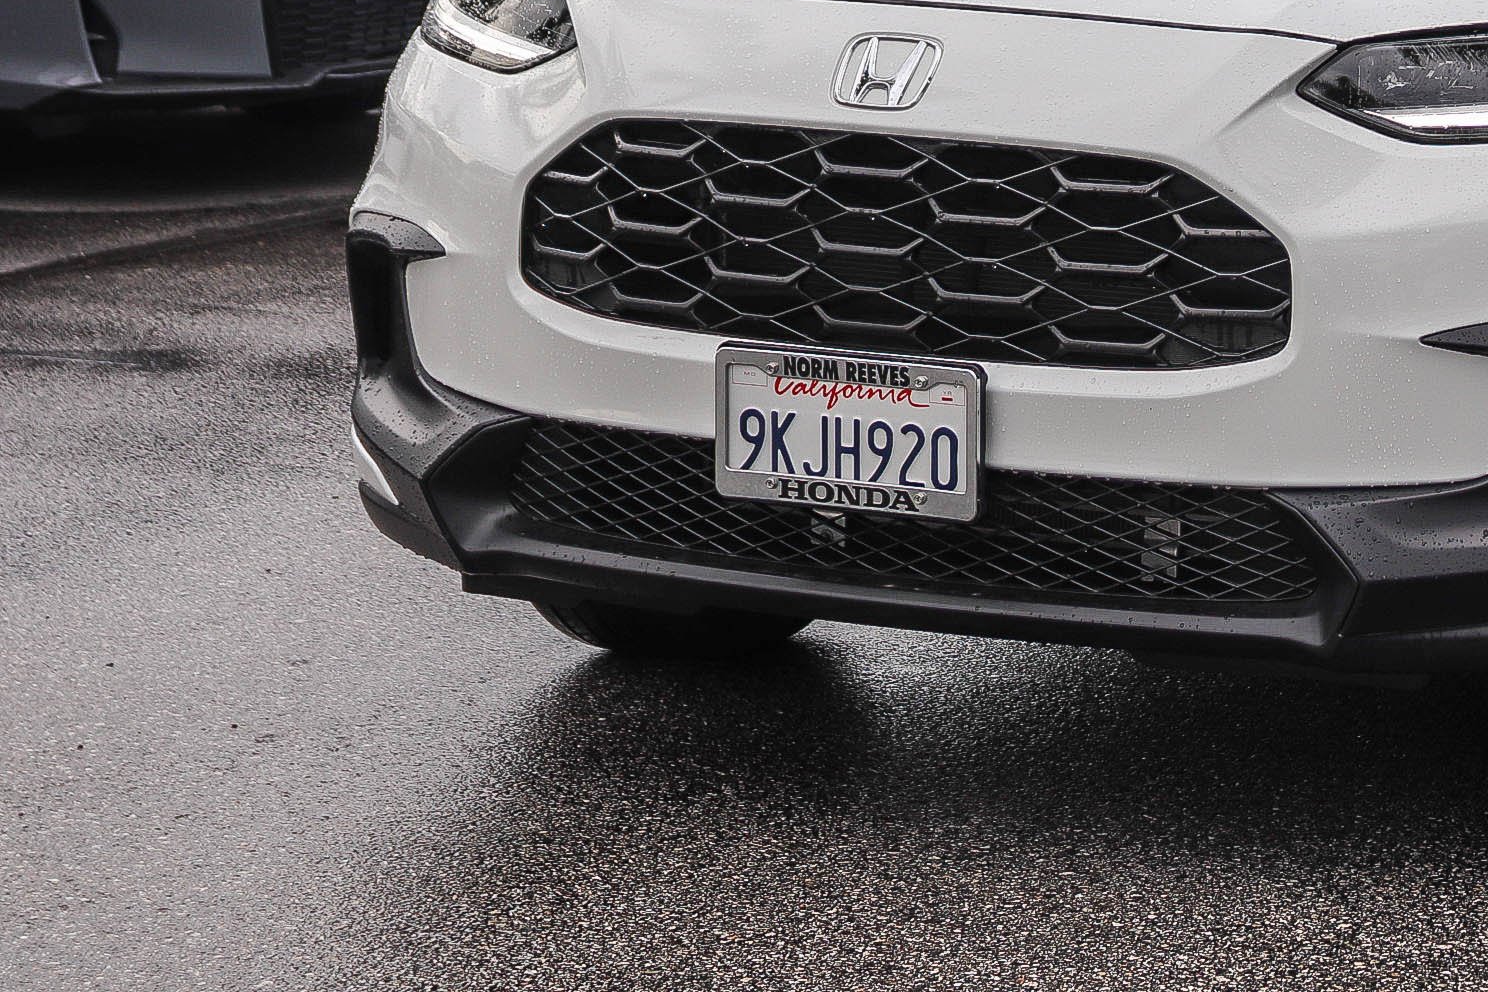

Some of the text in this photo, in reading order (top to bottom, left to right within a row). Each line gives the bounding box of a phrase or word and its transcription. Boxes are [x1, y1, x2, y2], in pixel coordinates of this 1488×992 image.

[783, 355, 911, 388] NORM REEVES
[774, 376, 930, 410] California
[739, 408, 960, 491] 9KJH920
[777, 477, 920, 513] HONDA
